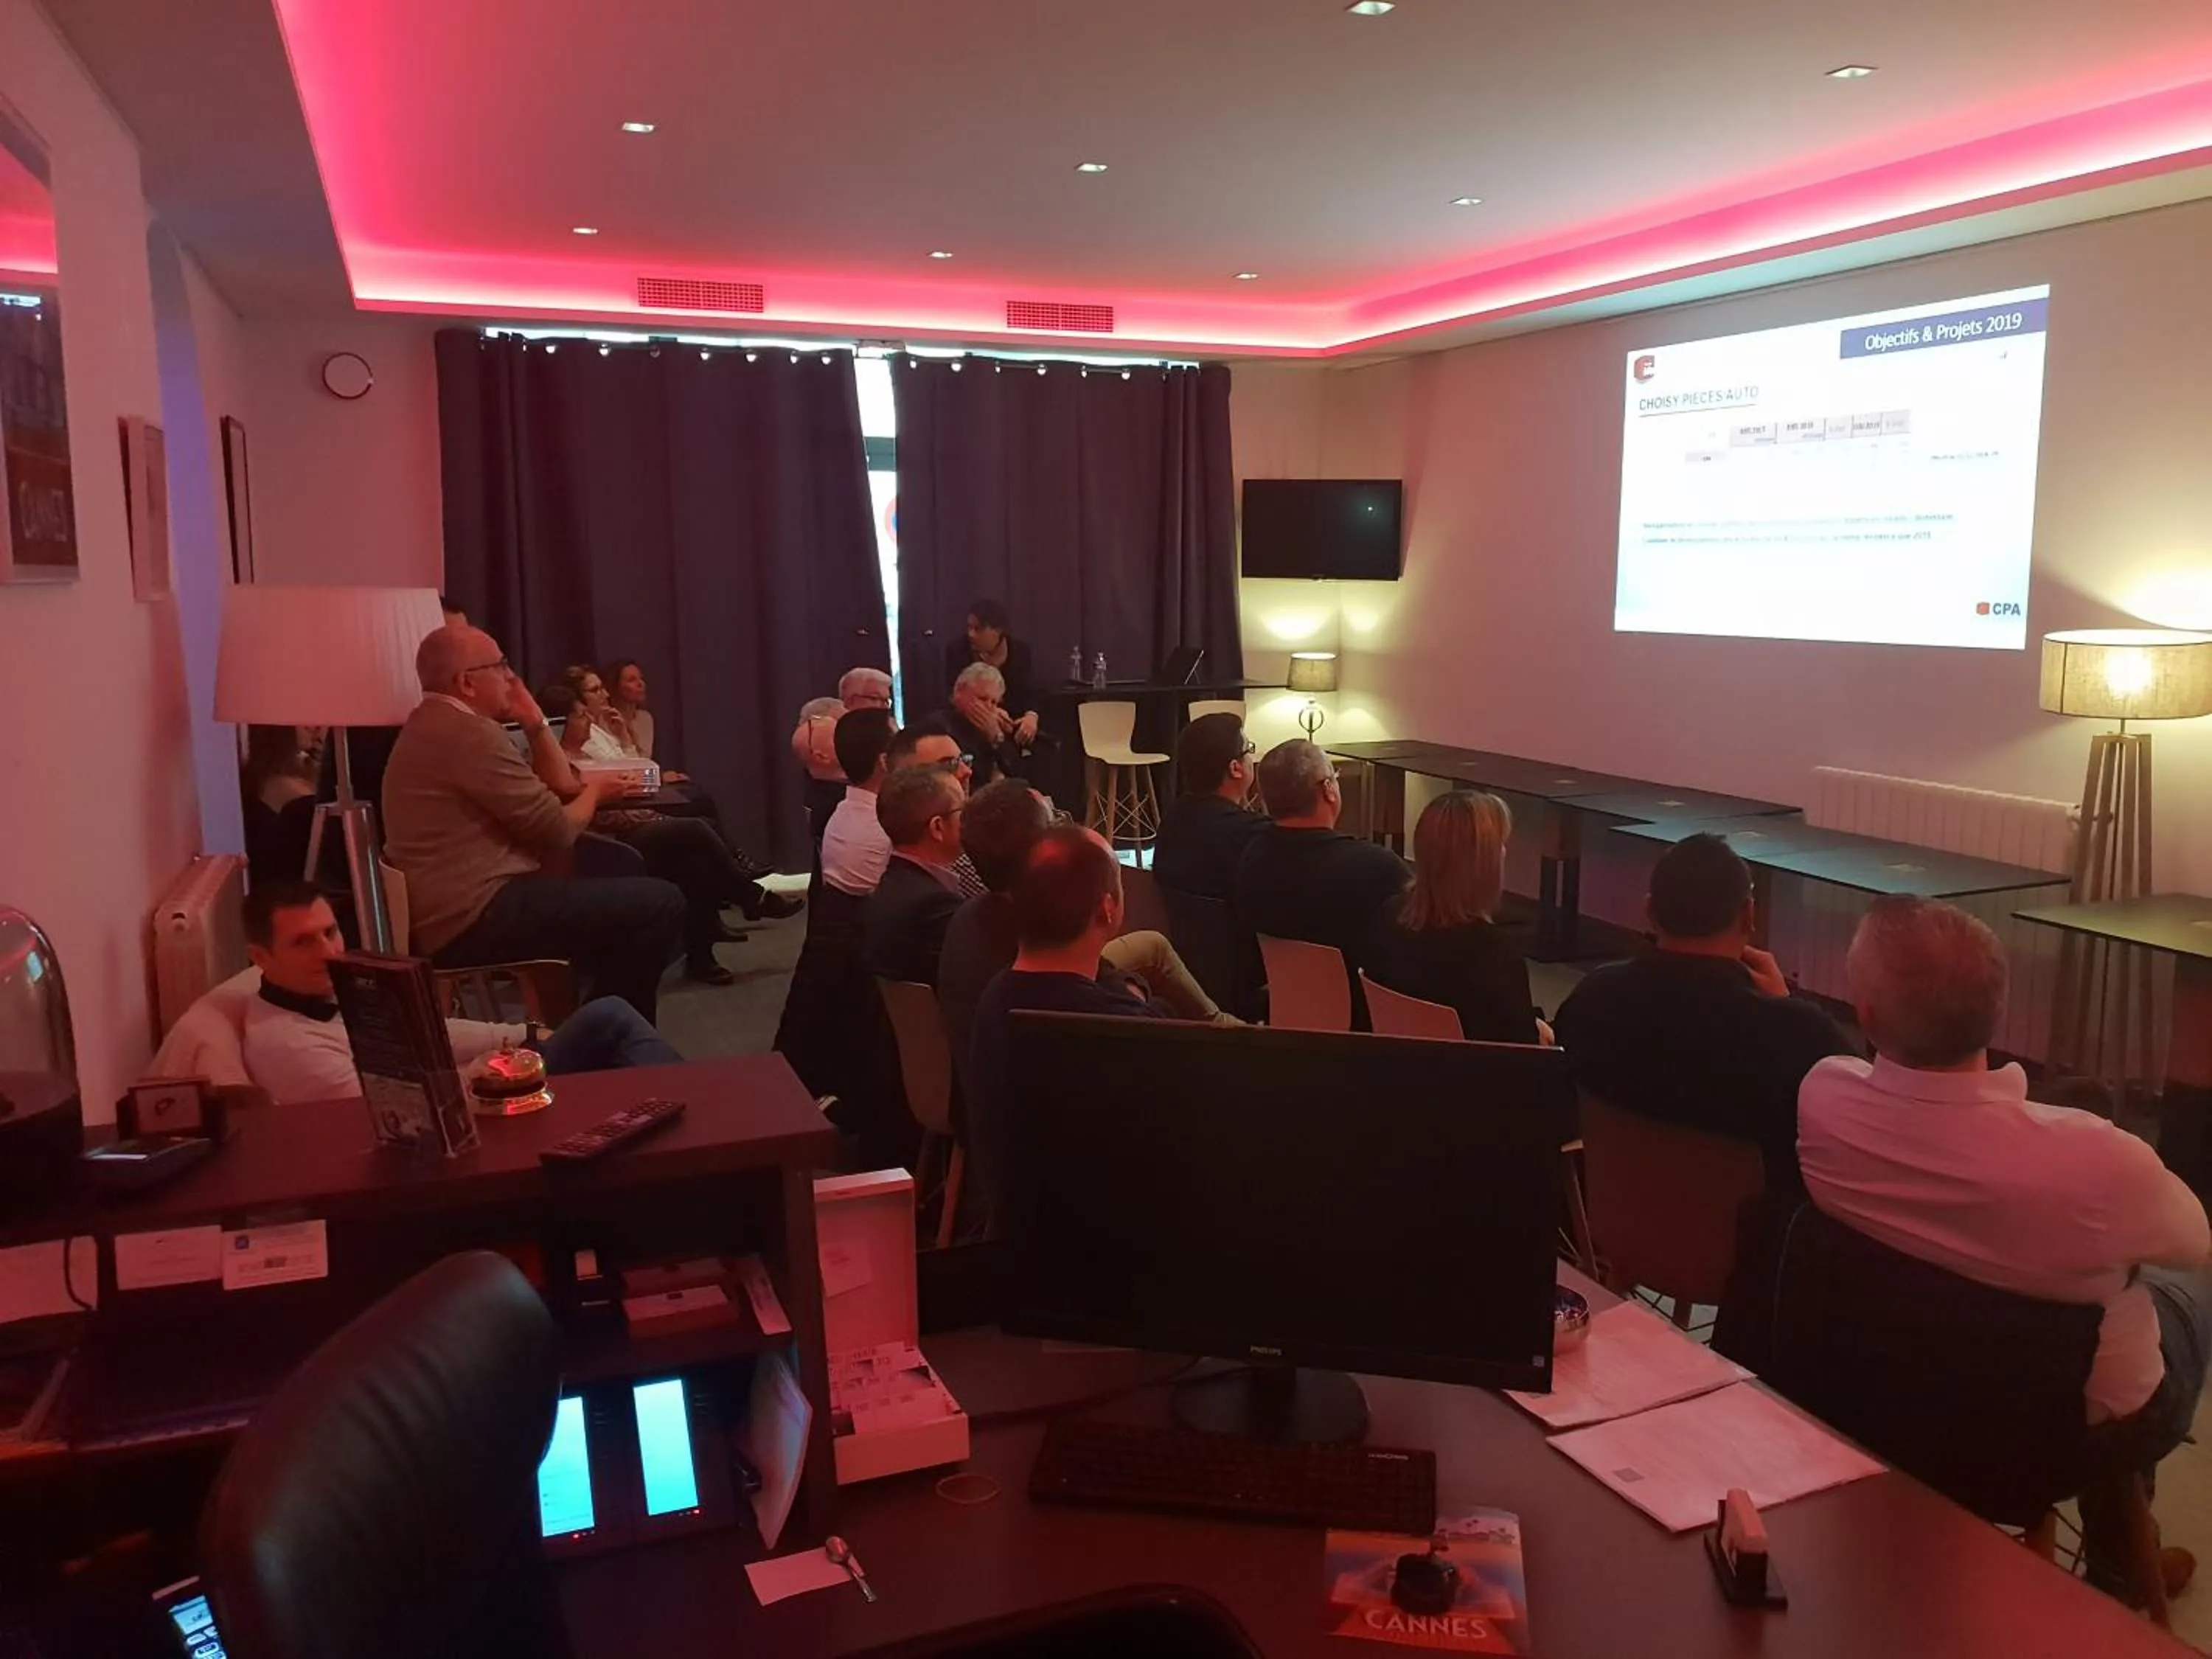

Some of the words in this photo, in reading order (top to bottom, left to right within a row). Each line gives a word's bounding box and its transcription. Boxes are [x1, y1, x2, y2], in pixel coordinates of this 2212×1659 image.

[1865, 327, 1919, 351] Objectifs
[1922, 326, 1933, 341] &
[1936, 321, 1983, 341] Projets
[1986, 312, 2023, 333] 2019
[1639, 395, 1680, 410] CHOISY
[1682, 390, 1723, 405] PIECES
[1725, 386, 1759, 400] AUTO
[1993, 602, 2021, 616] CPA
[1366, 1610, 1488, 1638] CANNES
